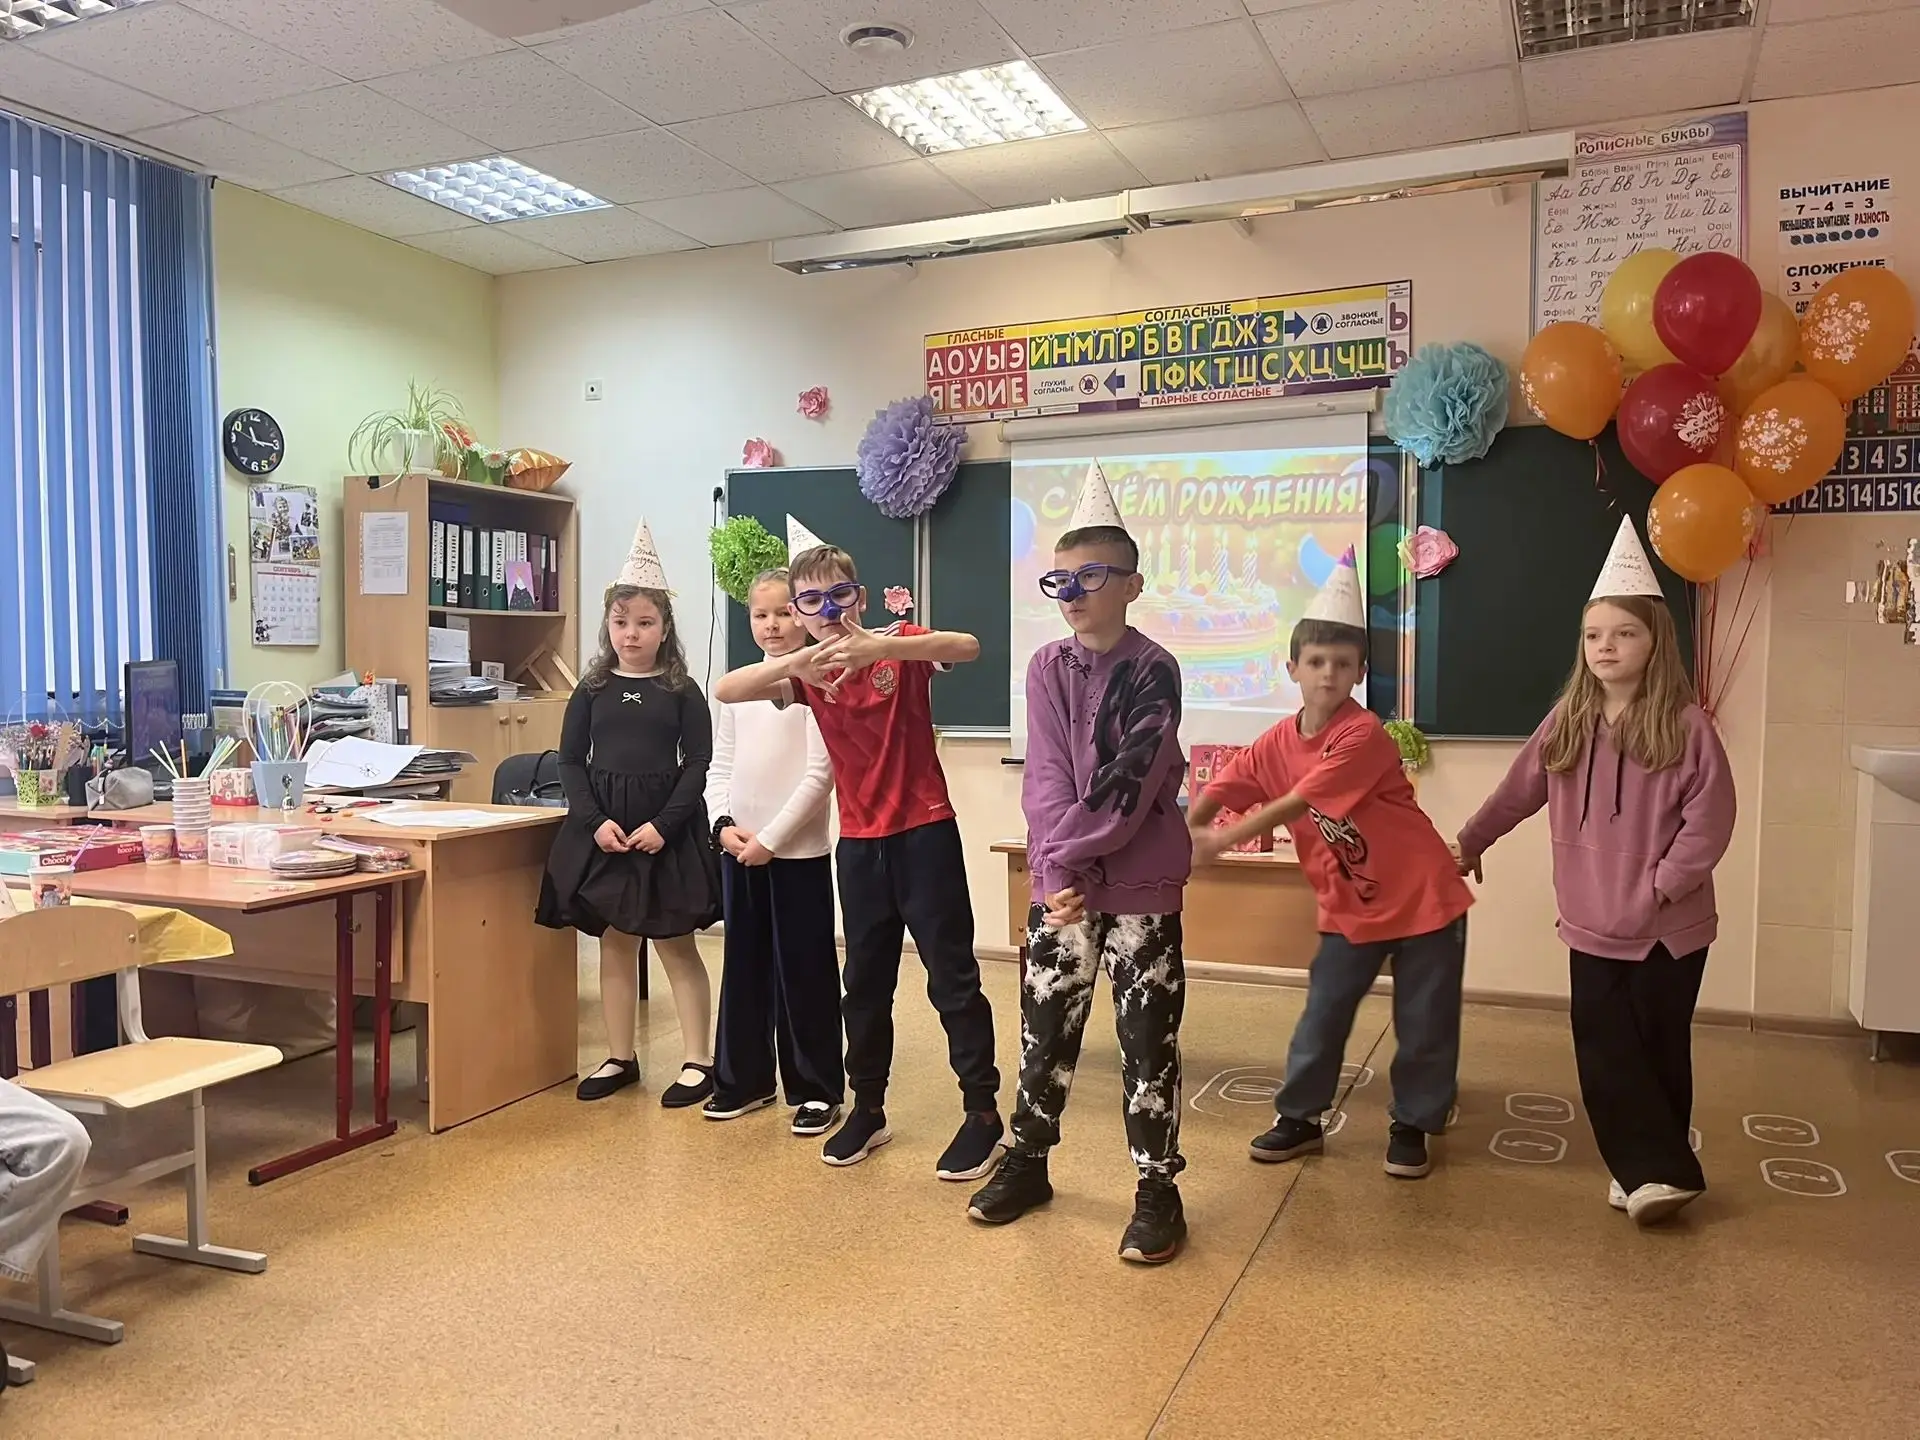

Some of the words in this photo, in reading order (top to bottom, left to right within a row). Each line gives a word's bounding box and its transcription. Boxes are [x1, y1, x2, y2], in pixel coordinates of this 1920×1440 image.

[1576, 135, 1654, 154] РОПИСНЫЕ
[1661, 127, 1710, 144] БУКВЫ
[1780, 178, 1890, 200] ВЫЧИТАНИЕ
[1796, 204, 1805, 215] 7
[1824, 201, 1834, 212] 4
[1844, 201, 1854, 209] =
[1864, 197, 1874, 209] 3
[1854, 211, 1890, 225] РАЗНОСТЬ
[1792, 281, 1801, 292] 3
[1144, 304, 1232, 323] СОГЛАСНЫЕ
[1341, 311, 1379, 320] ЗВОНКИЕ
[1389, 301, 1408, 331] Ь
[1335, 317, 1384, 329] СОГЛАСНЫЕ
[947, 328, 1004, 345] ГЛАСНЫЕ
[1034, 386, 1074, 395] СОГЛАСНЫЕ
[1151, 393, 1198, 406] ПАРНЫЕ
[1201, 387, 1272, 402] СОГЛАСНЫЕ
[250, 413, 260, 422] 12
[273, 439, 279, 450] 3
[261, 460, 268, 470] 5
[1847, 446, 1860, 470] 3
[1870, 445, 1884, 469] 4
[1895, 444, 1907, 469] 5
[251, 461, 259, 471] 6
[1041, 486, 1070, 519] С
[1801, 486, 1819, 508] 12
[1825, 484, 1845, 508] 13
[1850, 484, 1872, 507] 14
[1877, 483, 1898, 506] 15
